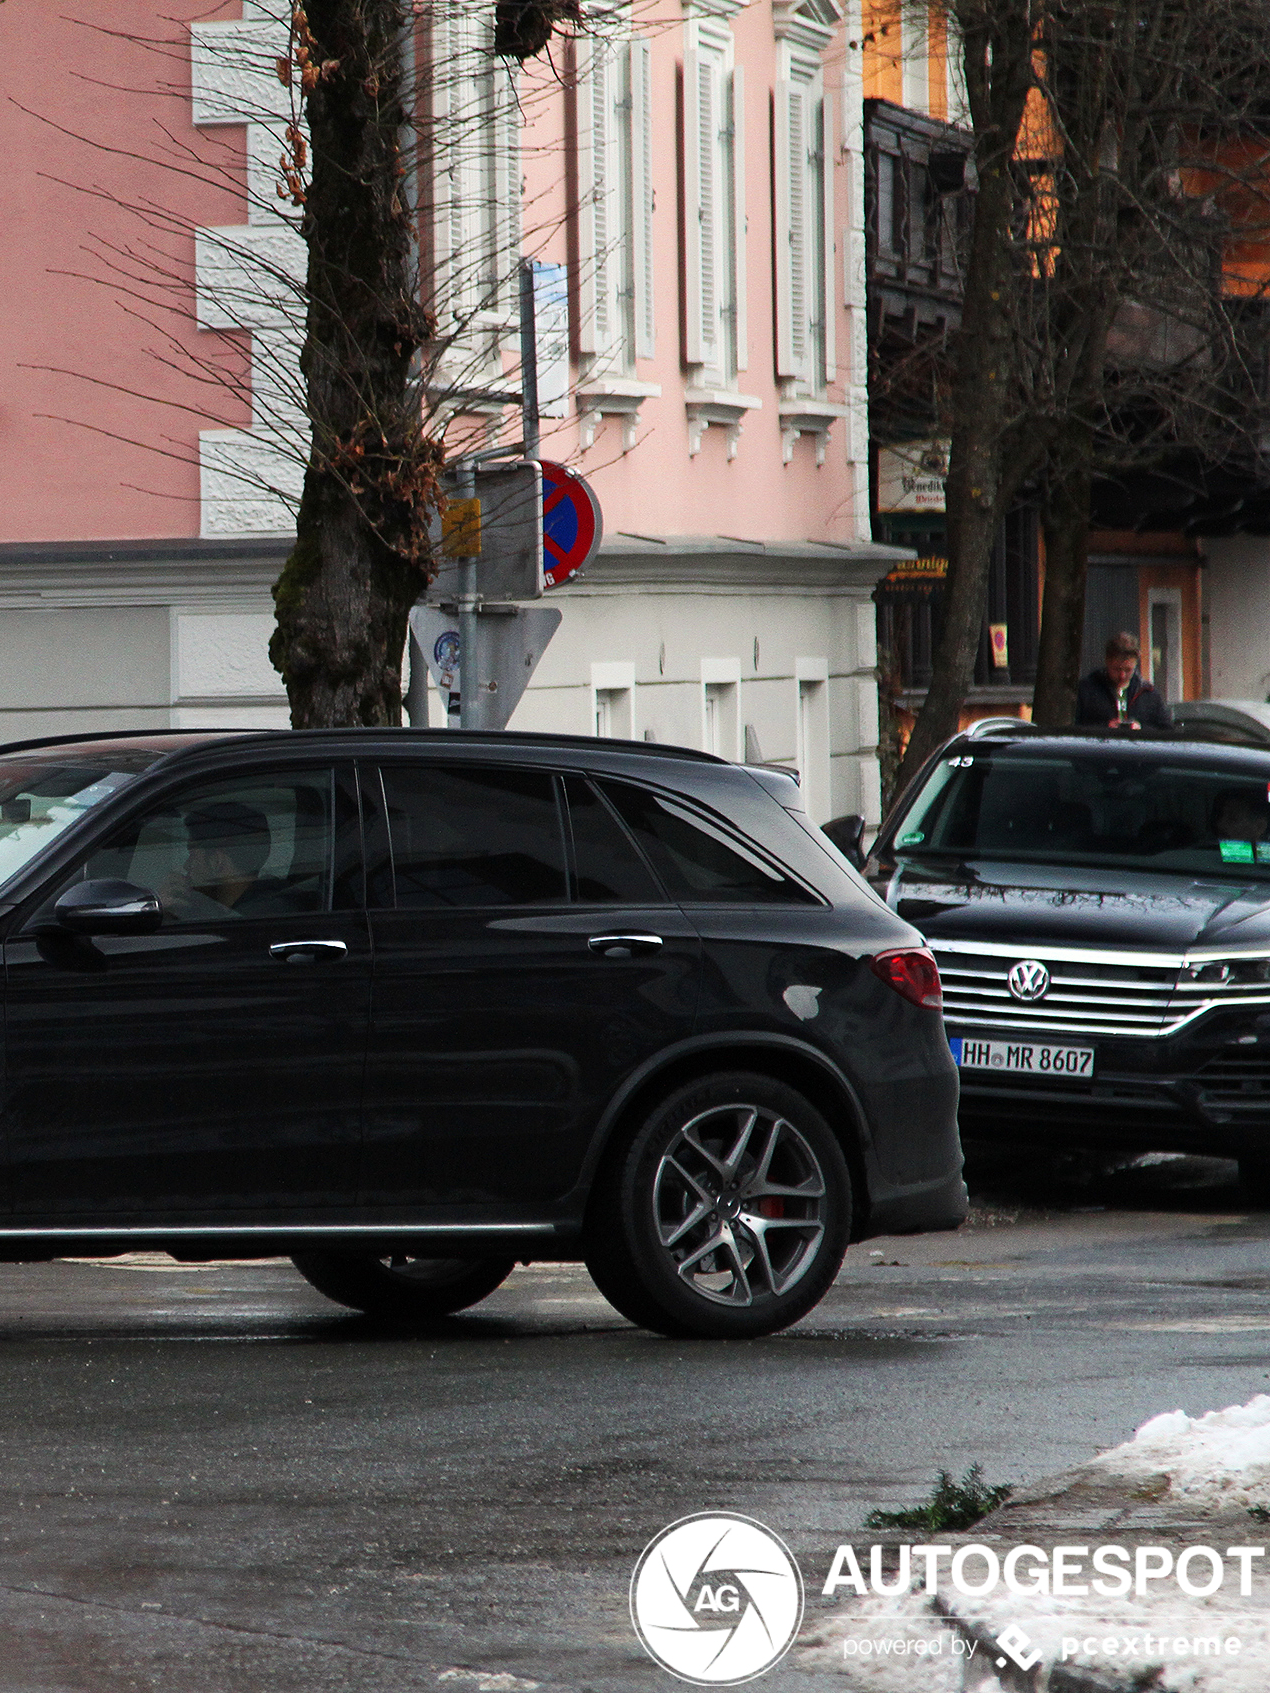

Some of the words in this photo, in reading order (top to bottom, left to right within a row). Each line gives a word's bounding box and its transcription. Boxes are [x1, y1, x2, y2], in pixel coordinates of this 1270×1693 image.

[948, 756, 974, 768] 43
[963, 1042, 991, 1066] HH
[1006, 1045, 1033, 1070] MR
[1039, 1047, 1093, 1074] 8607
